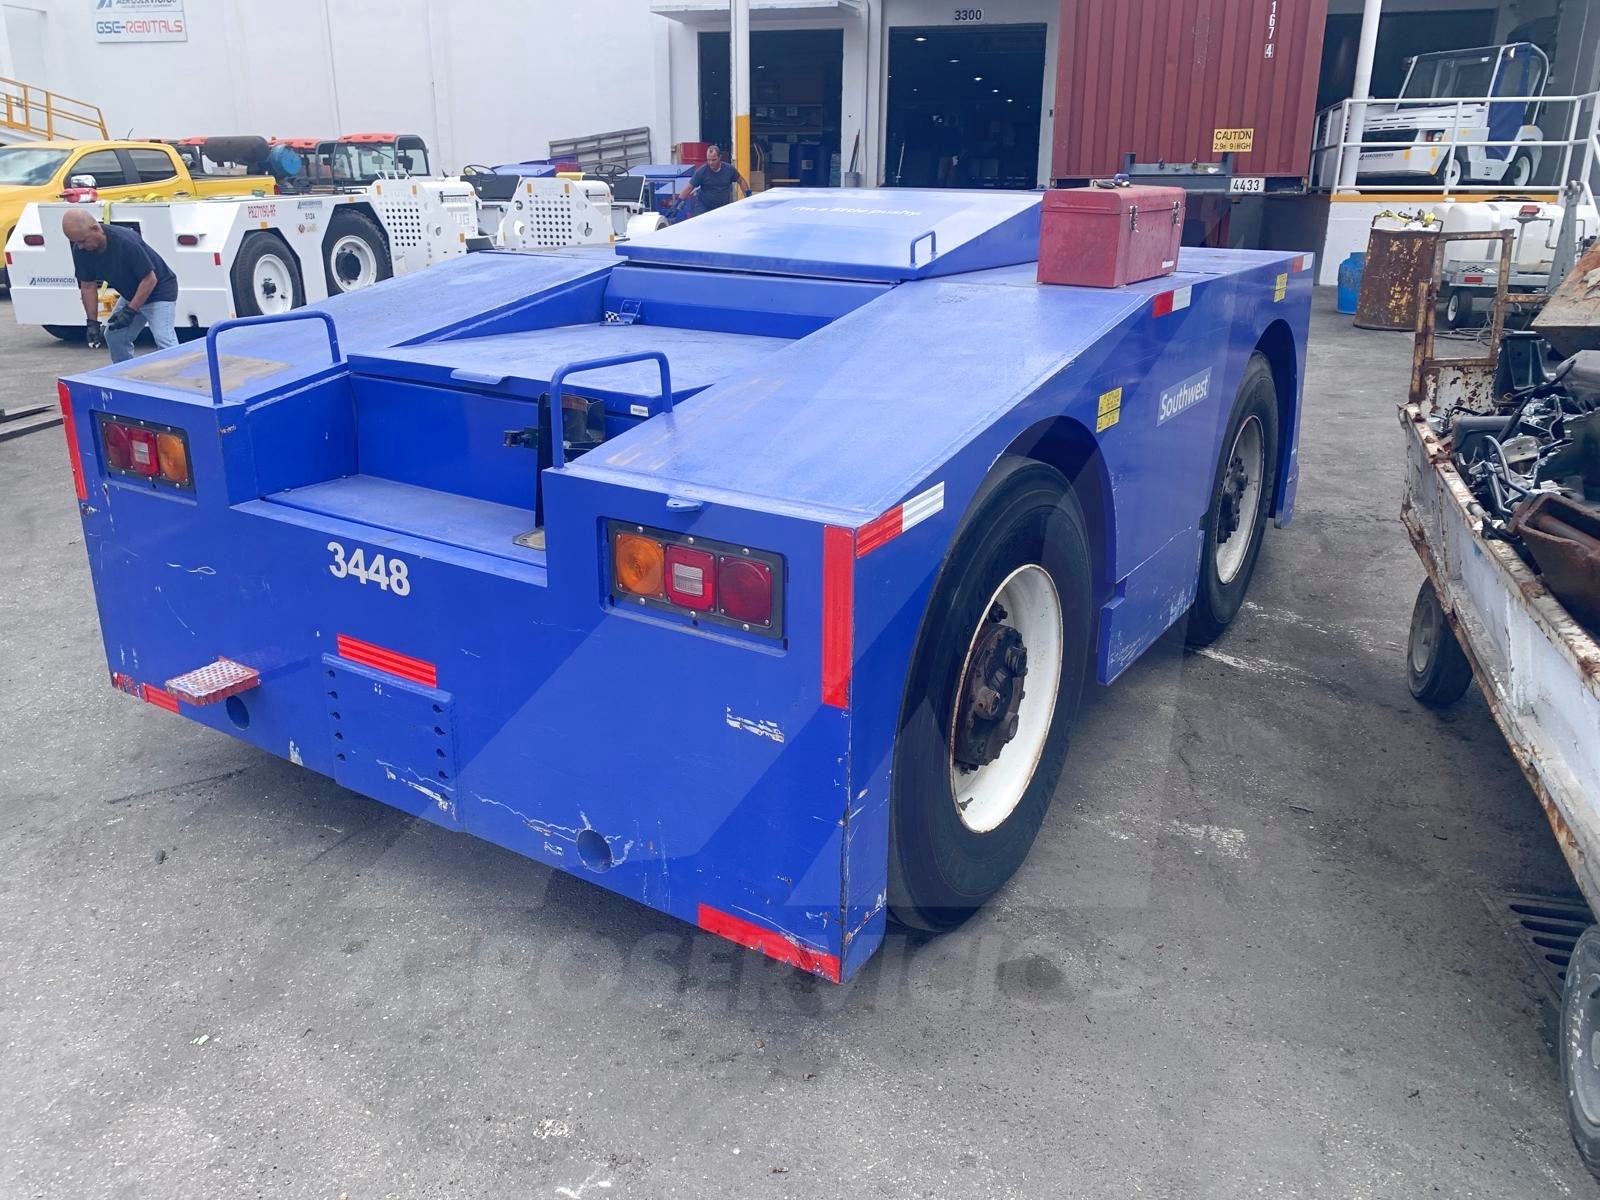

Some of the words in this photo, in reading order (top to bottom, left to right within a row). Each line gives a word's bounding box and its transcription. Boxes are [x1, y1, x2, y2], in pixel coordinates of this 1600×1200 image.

[954, 9, 982, 21] 3300
[1233, 179, 1260, 191] 4433
[1160, 375, 1209, 421] Southwest
[327, 541, 411, 596] 3448
